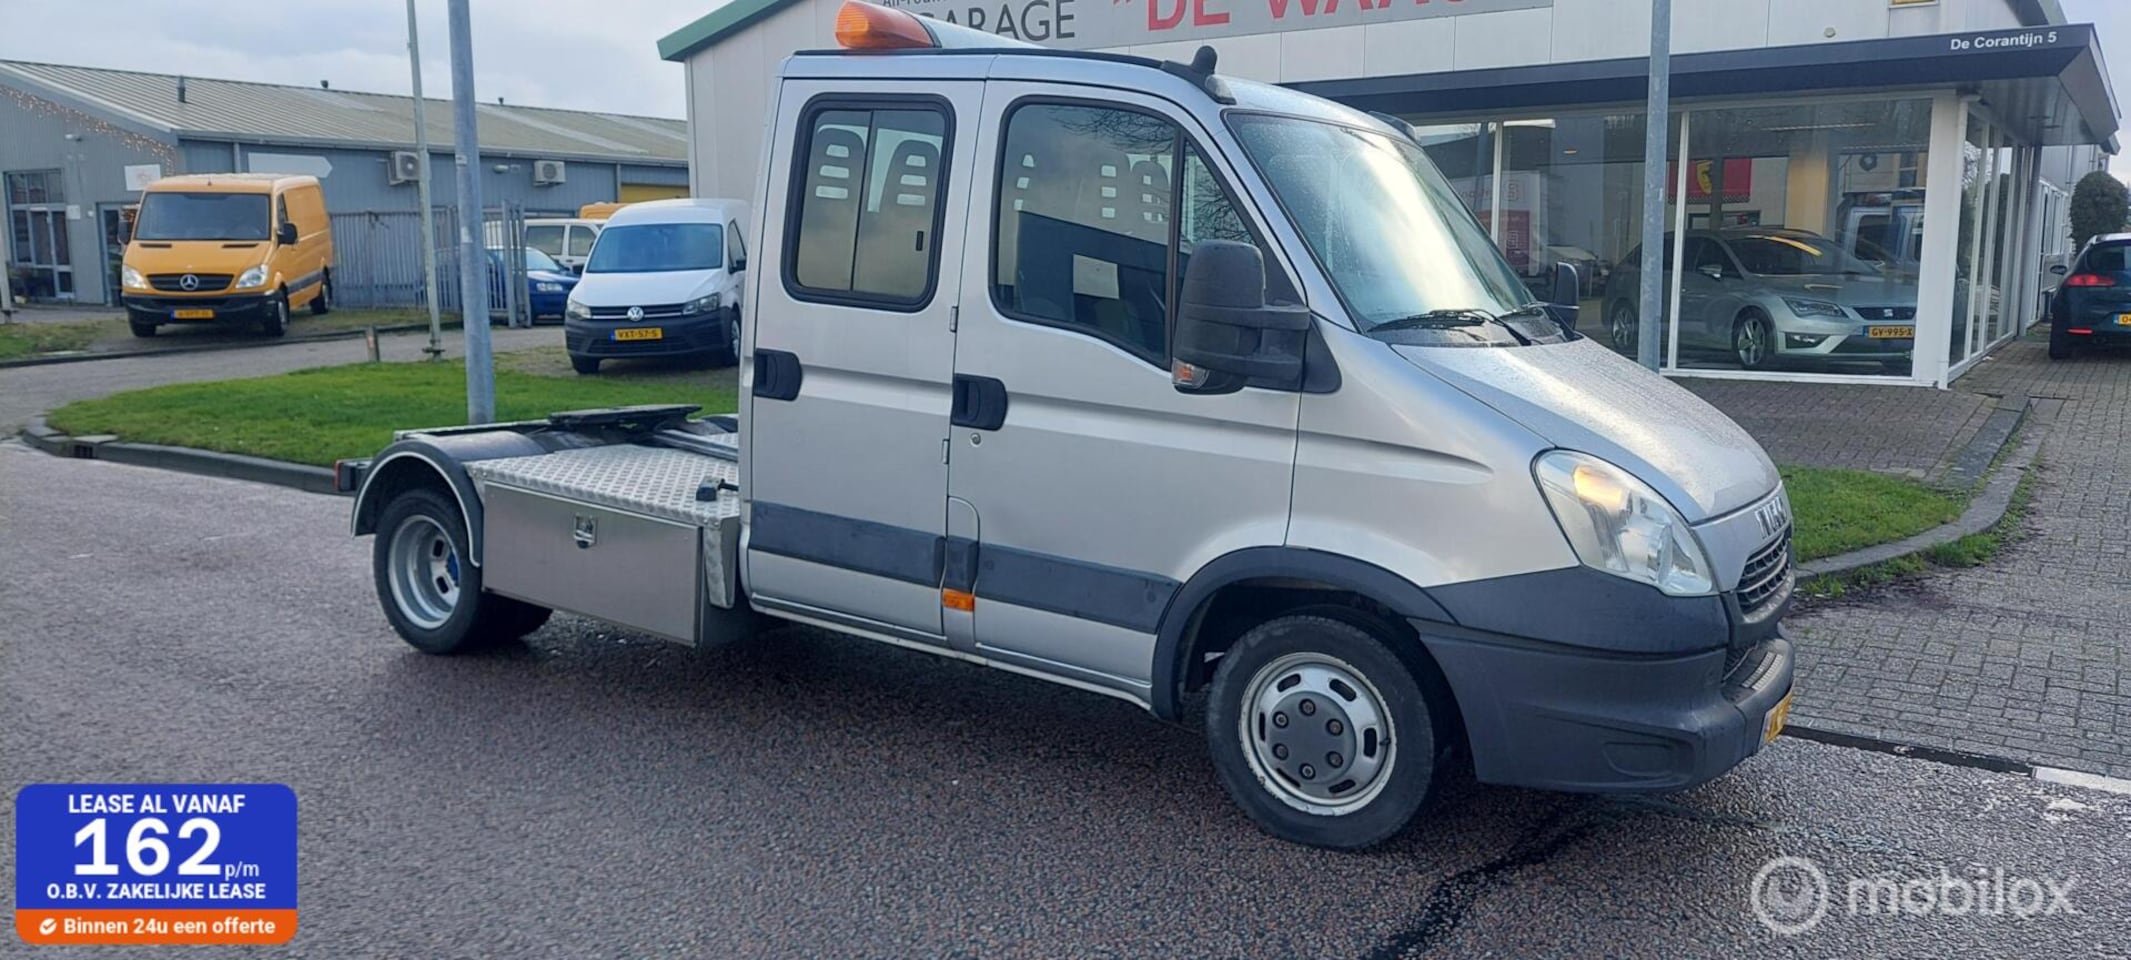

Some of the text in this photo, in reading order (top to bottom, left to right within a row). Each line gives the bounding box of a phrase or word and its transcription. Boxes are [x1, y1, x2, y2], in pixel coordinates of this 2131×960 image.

[1950, 31, 2058, 50] De Corantijn 5
